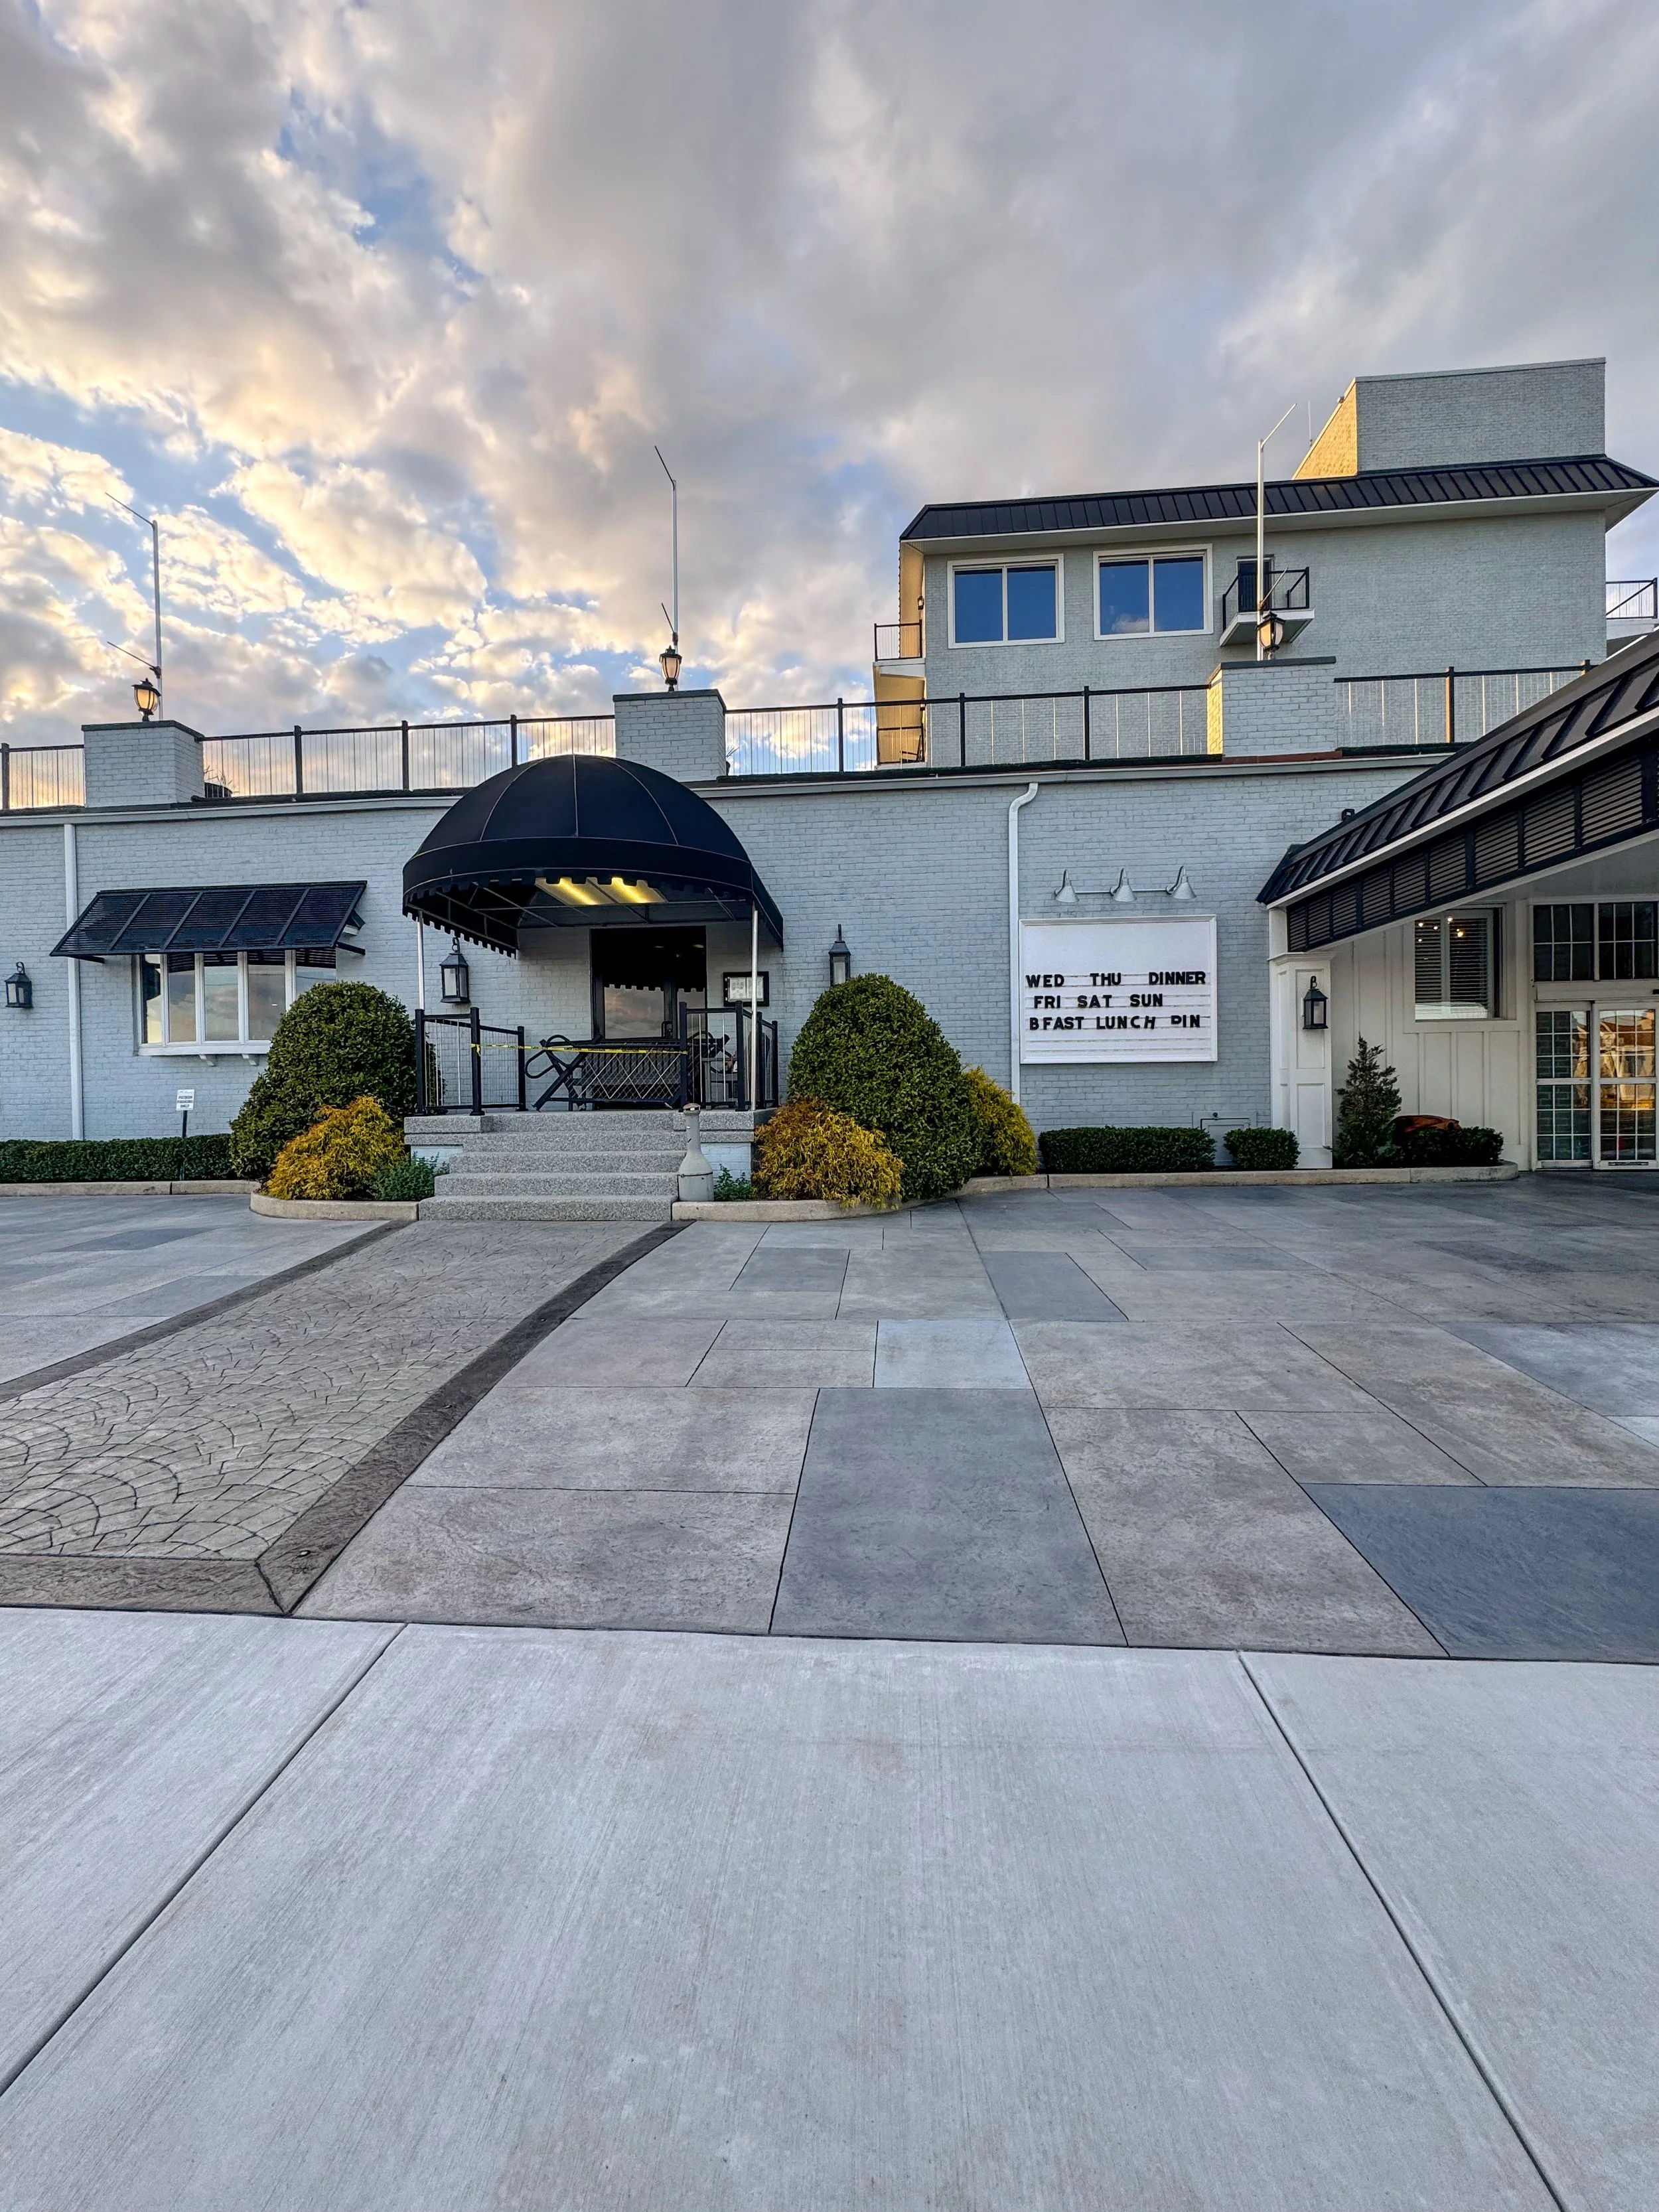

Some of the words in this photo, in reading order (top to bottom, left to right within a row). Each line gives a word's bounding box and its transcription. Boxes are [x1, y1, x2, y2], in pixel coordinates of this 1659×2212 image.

[1026, 974, 1064, 988] WED
[1090, 972, 1121, 986] THU
[1149, 971, 1206, 986] DINNER
[1034, 995, 1060, 1009] FRI
[1077, 994, 1112, 1009] SAT
[1129, 993, 1163, 1007] SUN
[1096, 1015, 1156, 1030] LUNCH
